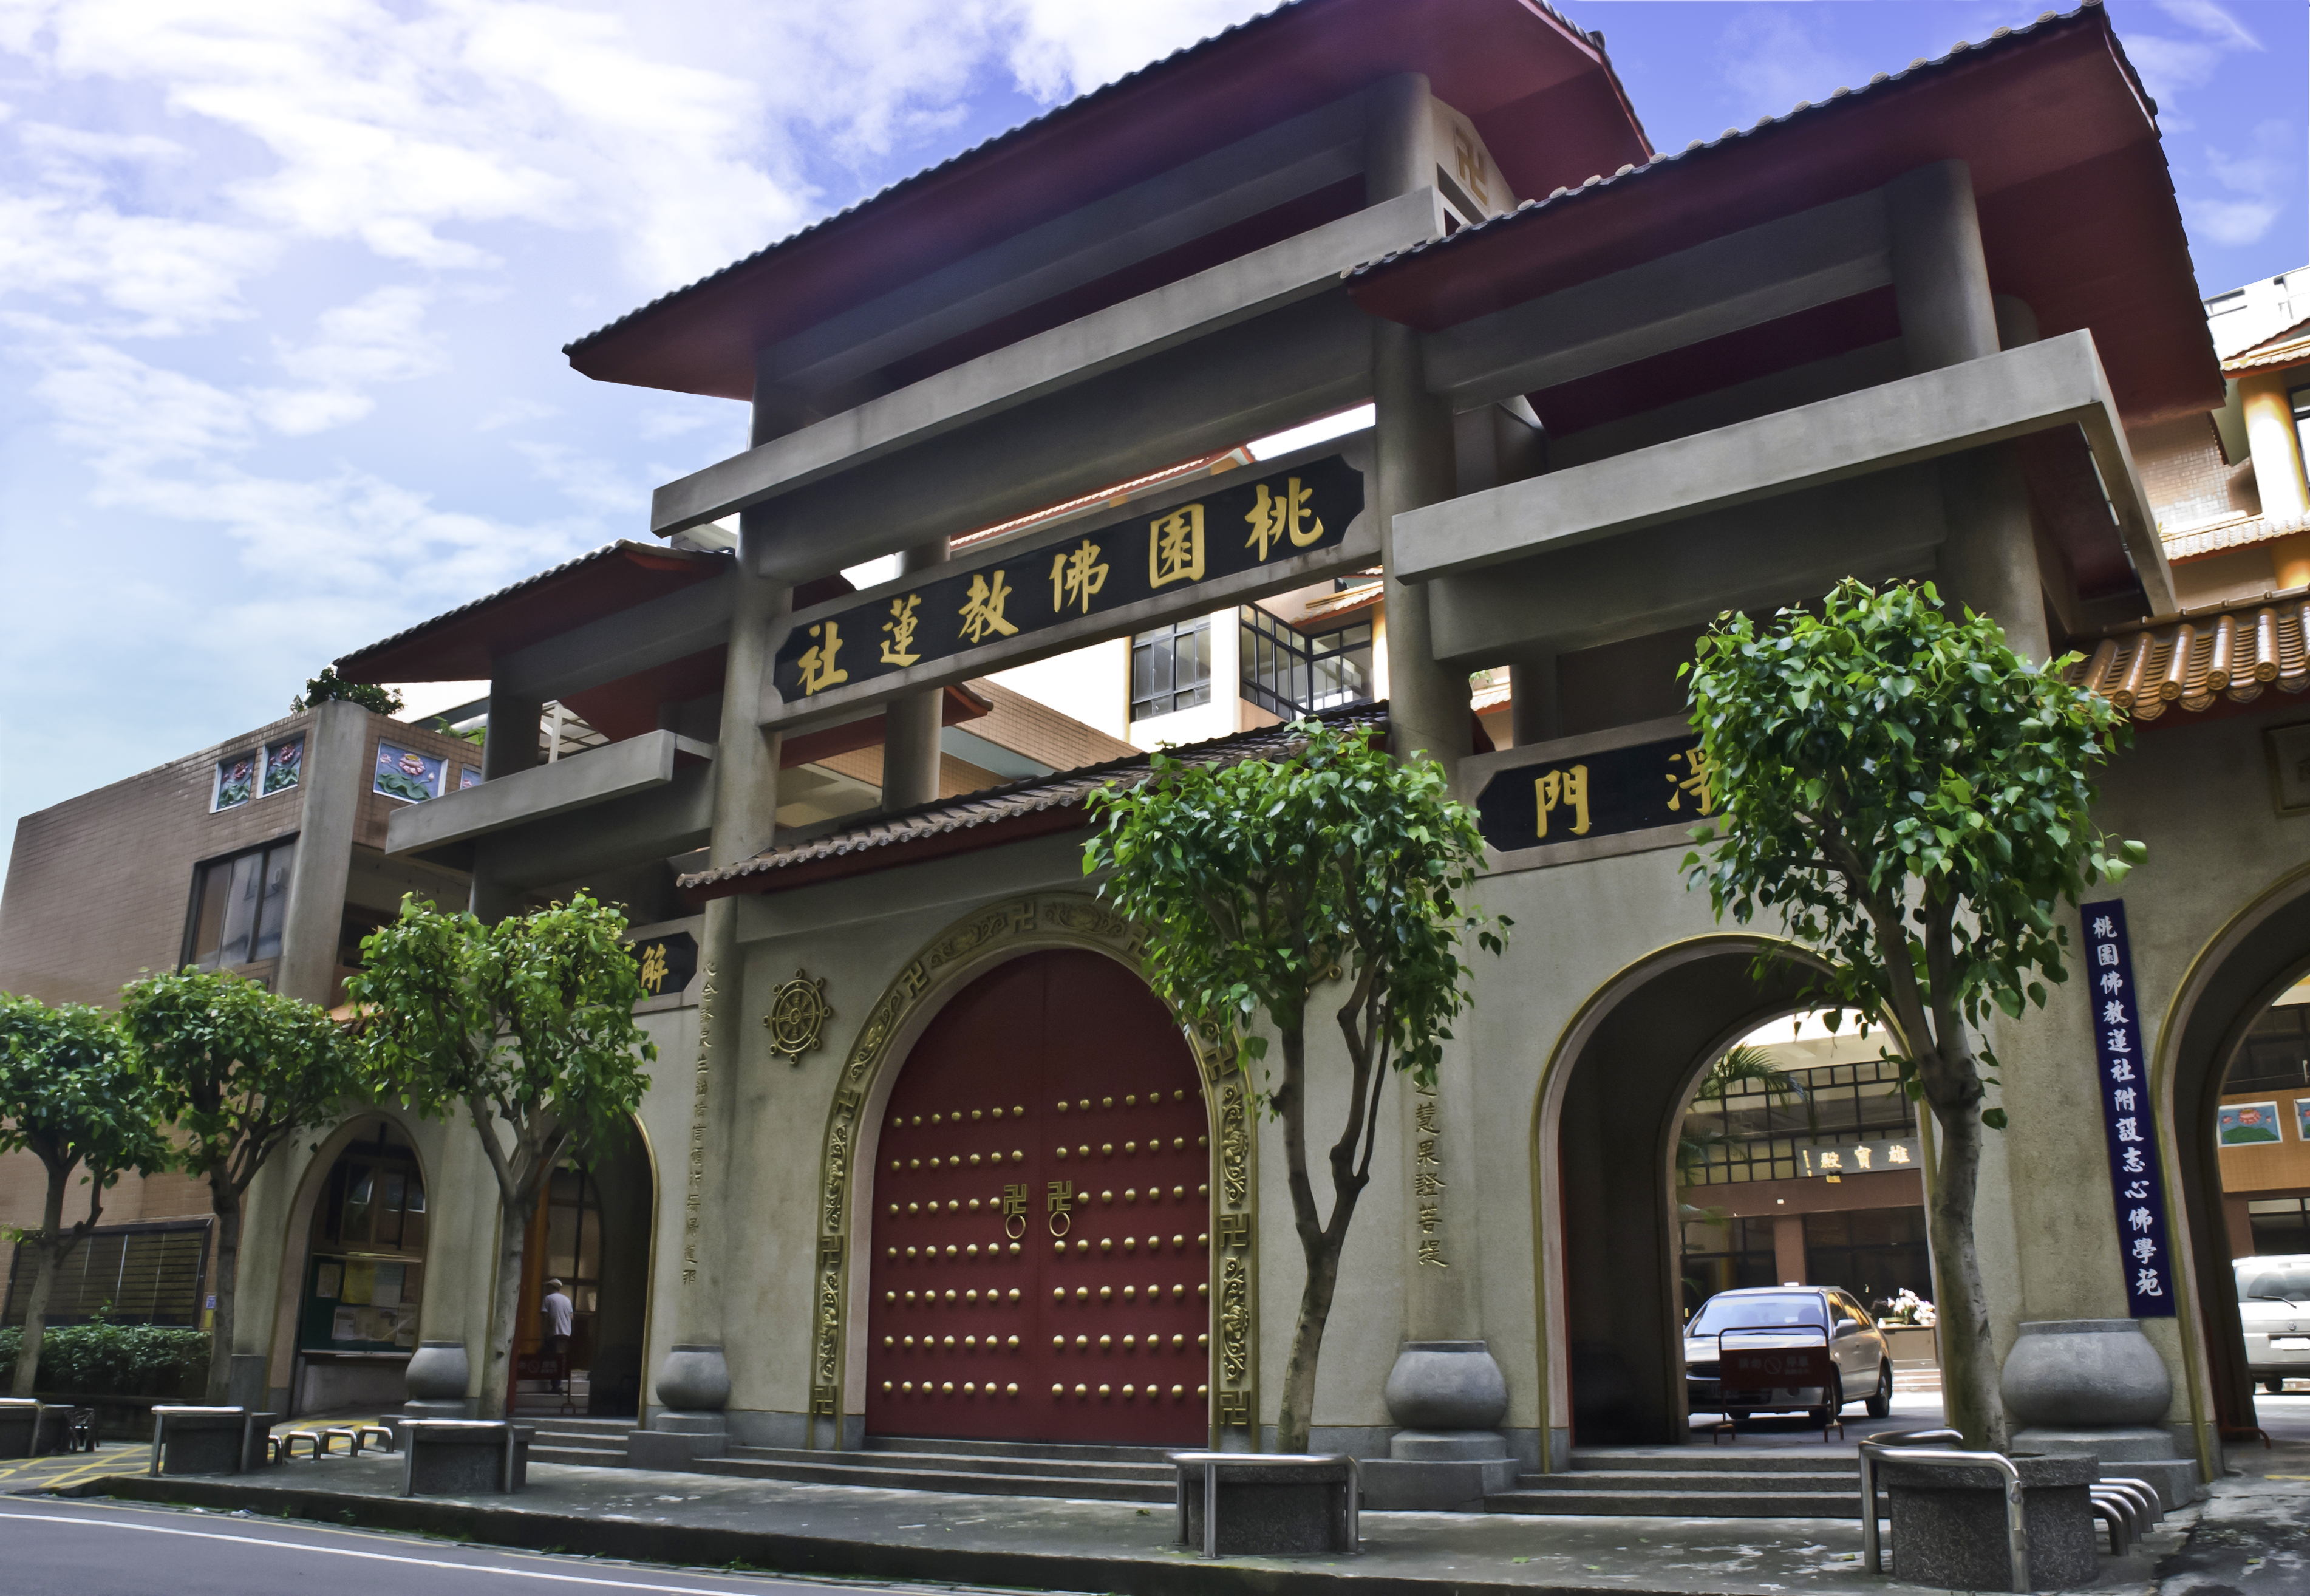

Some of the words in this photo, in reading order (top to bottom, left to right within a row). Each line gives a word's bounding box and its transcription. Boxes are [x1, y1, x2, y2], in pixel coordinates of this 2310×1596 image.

[797, 476, 1324, 697] 桃園佛教蓮社
[640, 943, 669, 993] 解
[1821, 1144, 1910, 1169] 雄寶殿
[2093, 915, 2163, 1296] 桃園佛教蓮社附設志心佛學苑
